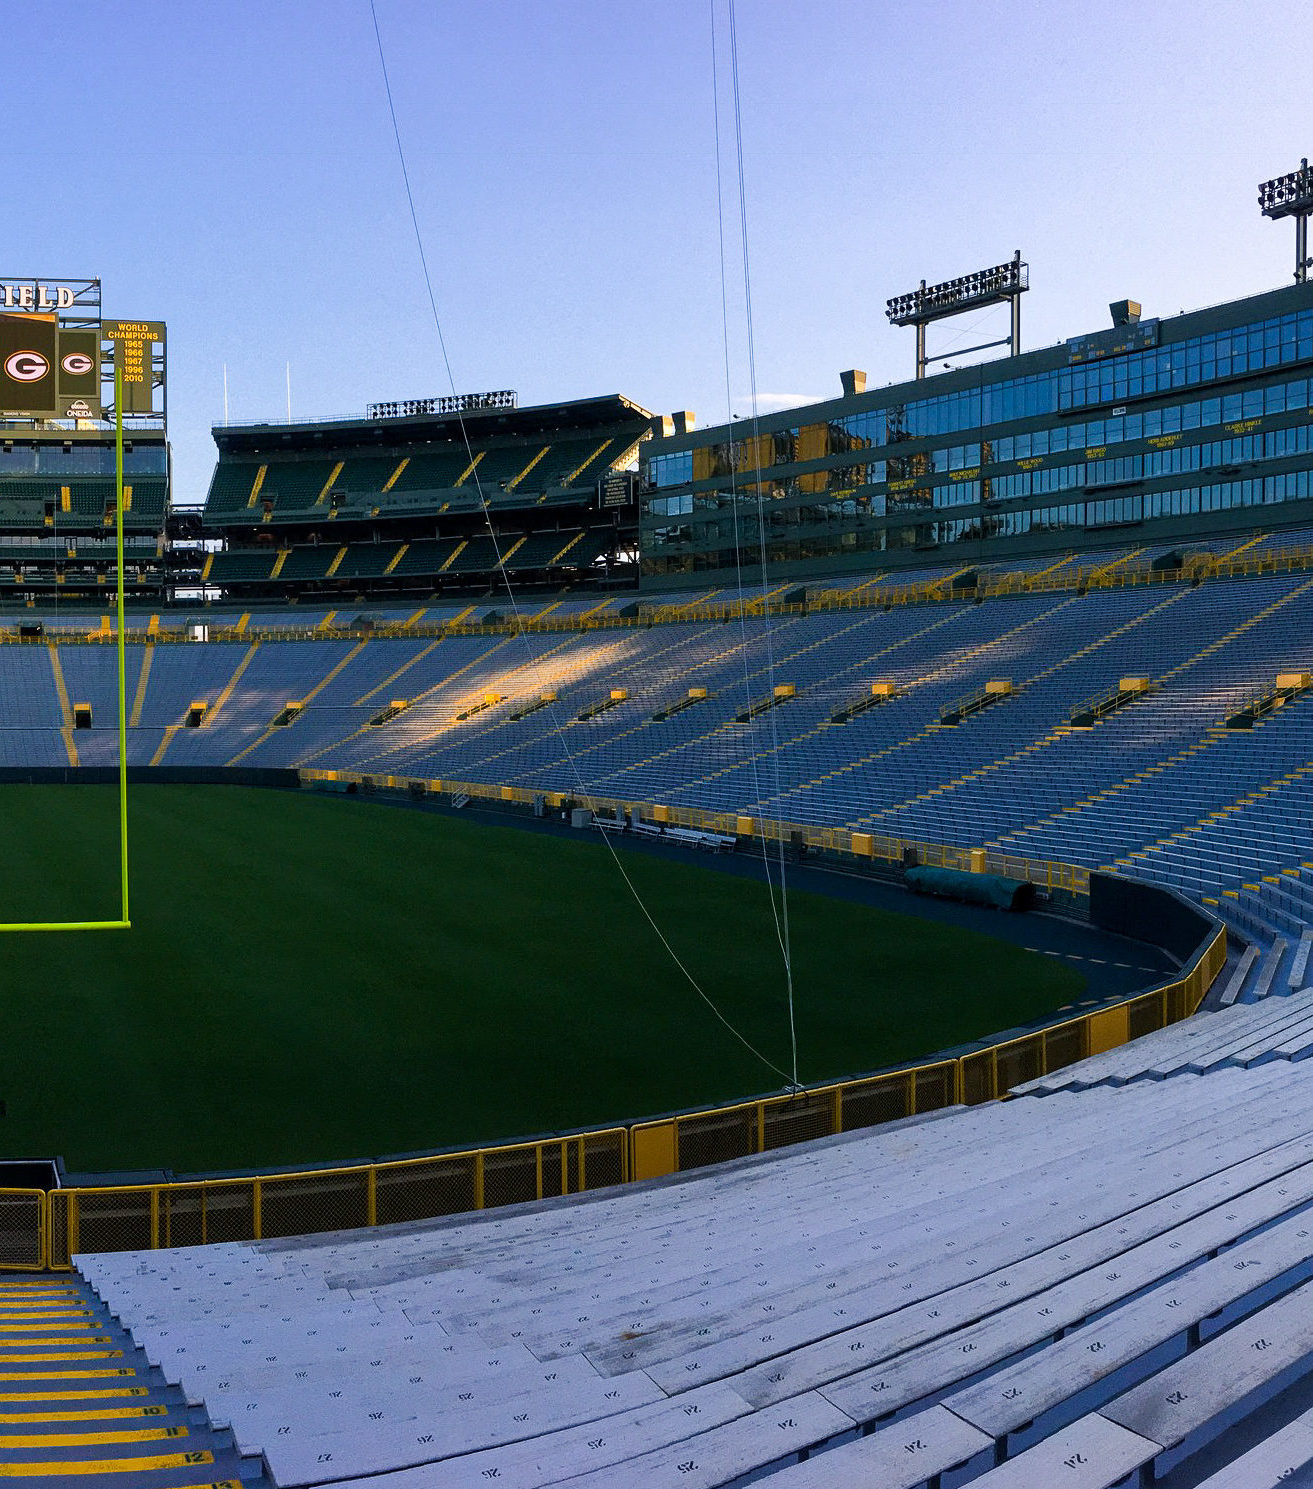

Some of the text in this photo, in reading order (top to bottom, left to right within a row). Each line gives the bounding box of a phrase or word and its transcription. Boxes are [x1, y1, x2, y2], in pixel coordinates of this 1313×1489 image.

[108, 332, 158, 340] CHAMPIONS
[124, 357, 143, 365] 1967
[847, 1341, 866, 1352] 22
[958, 1343, 978, 1354] 22
[1086, 1341, 1107, 1353] 22
[1250, 1338, 1273, 1351] 22
[767, 1373, 785, 1384] 23
[870, 1381, 890, 1393] 23
[603, 1390, 621, 1400] 24
[1001, 1387, 1023, 1400] 23
[1165, 1390, 1189, 1405] 23
[144, 1407, 159, 1415] 10
[683, 1404, 702, 1416] 24
[512, 1413, 530, 1423] 25
[777, 1418, 798, 1430] 24
[166, 1427, 178, 1436] 11
[416, 1434, 435, 1444] 26
[587, 1438, 607, 1450] 25
[904, 1439, 928, 1454] 24
[185, 1452, 204, 1463] 12
[1063, 1453, 1088, 1469] 24
[481, 1467, 502, 1479] 26
[677, 1460, 699, 1474] 25
